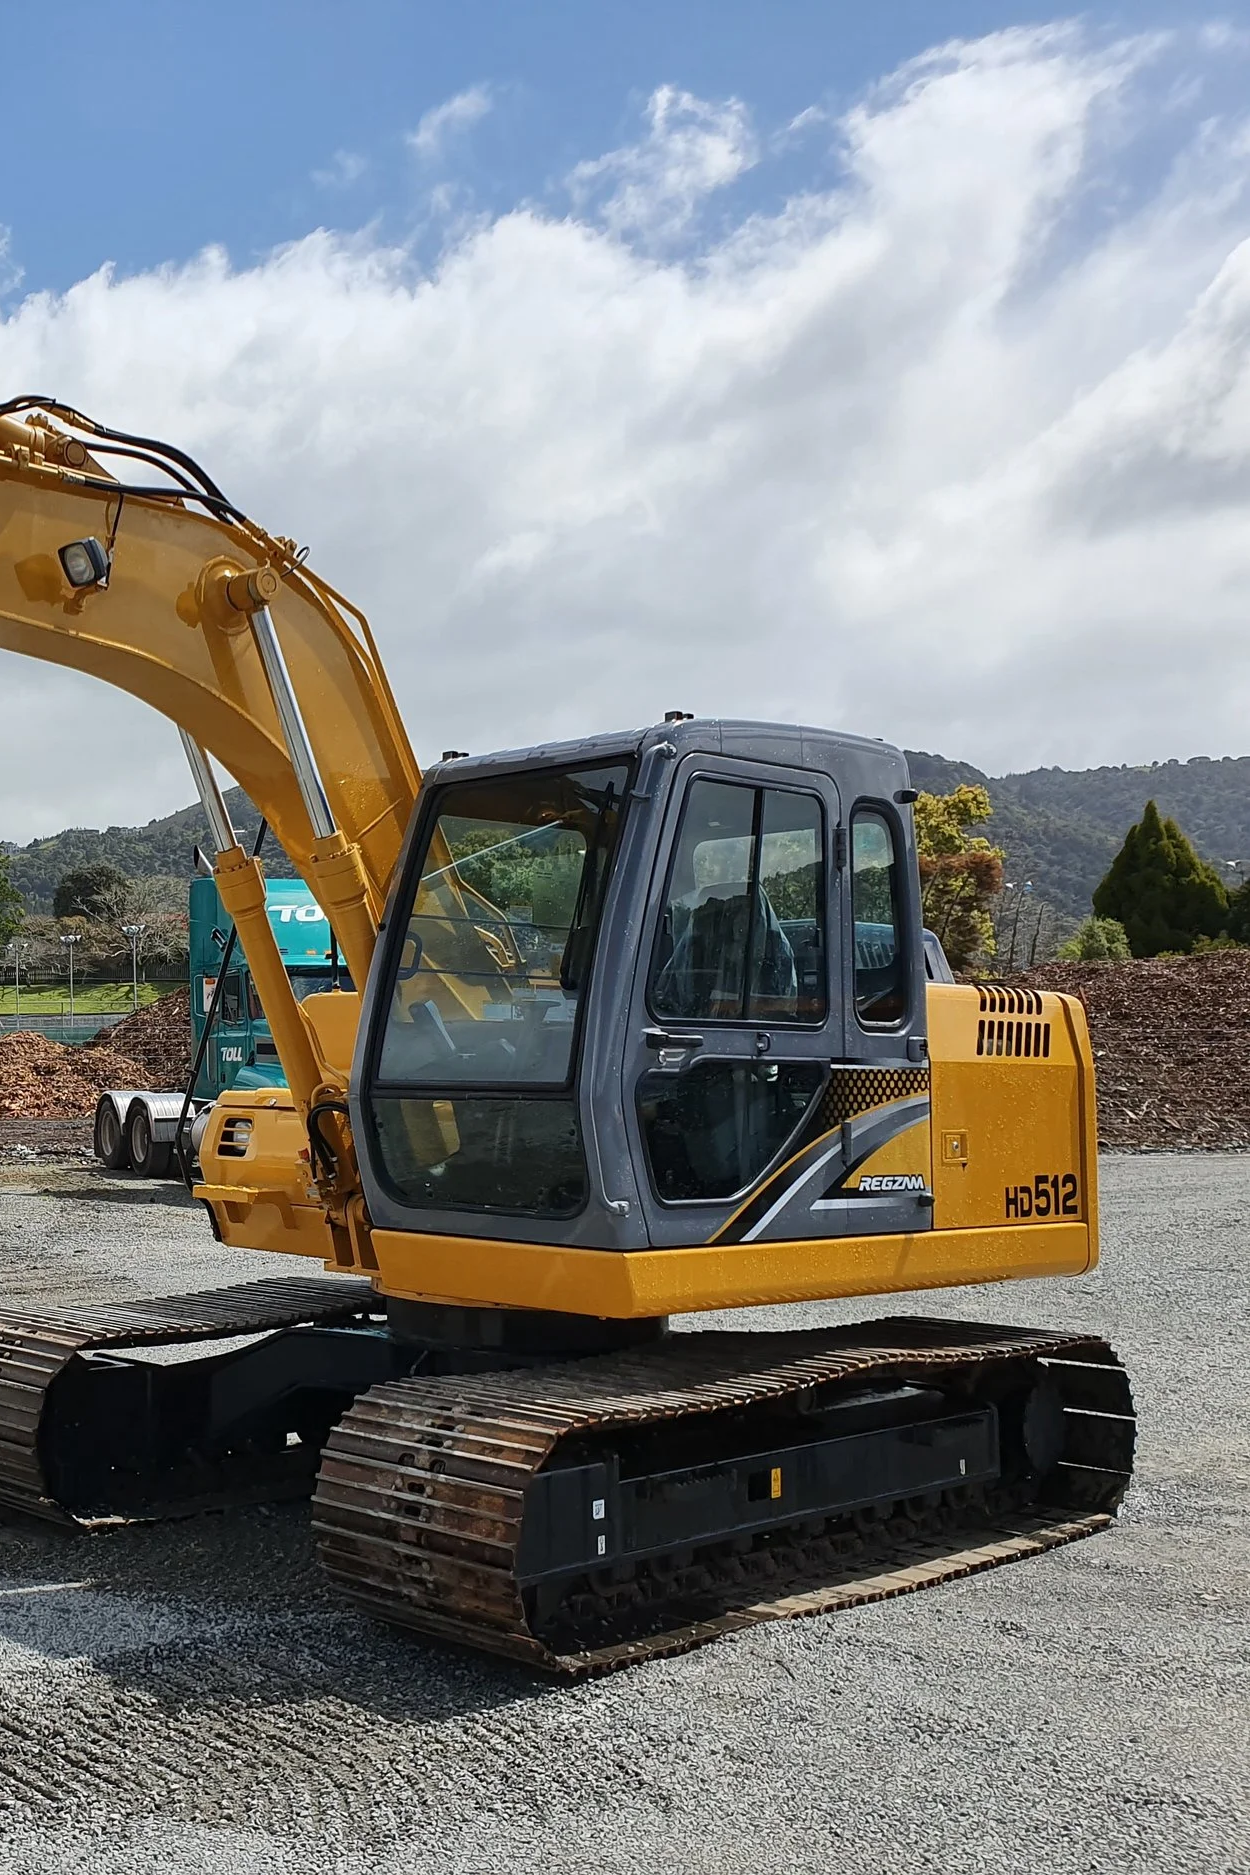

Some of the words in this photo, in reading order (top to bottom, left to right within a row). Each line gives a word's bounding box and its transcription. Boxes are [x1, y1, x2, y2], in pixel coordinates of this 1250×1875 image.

[268, 905, 325, 922] TO
[220, 1047, 242, 1061] TOLL
[859, 1175, 925, 1191] REGZAM
[1005, 1174, 1078, 1219] HD512
